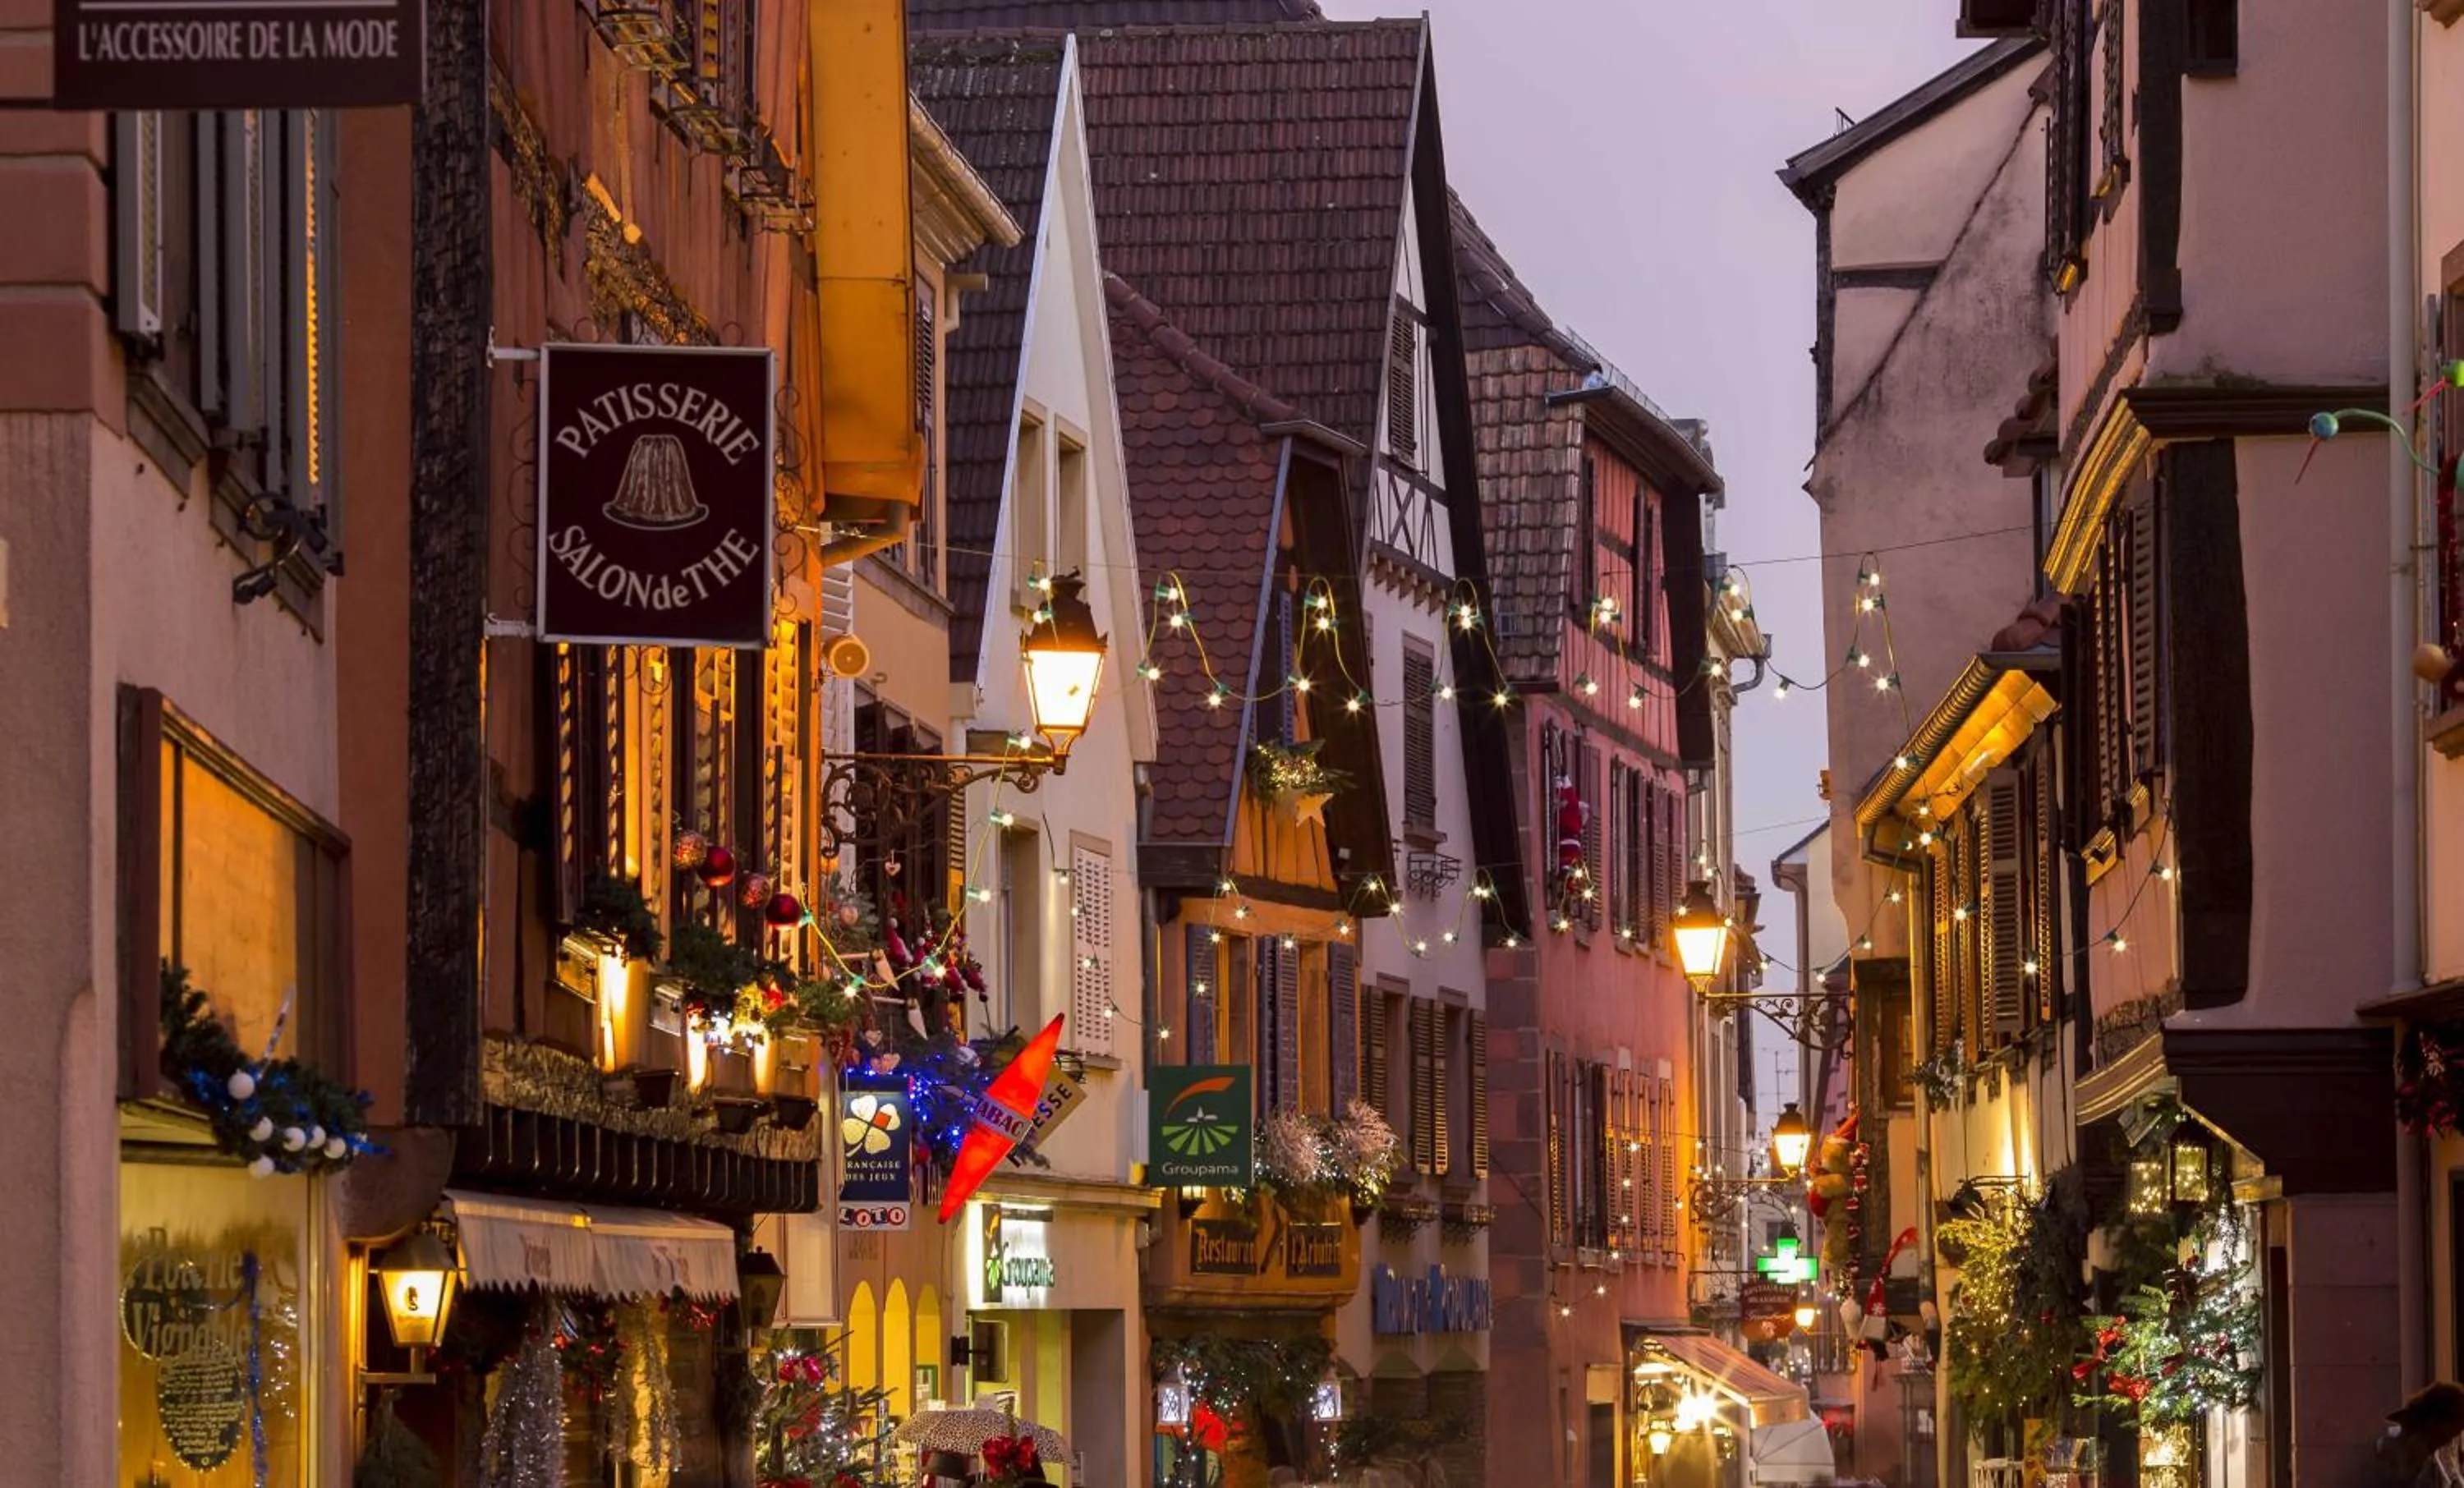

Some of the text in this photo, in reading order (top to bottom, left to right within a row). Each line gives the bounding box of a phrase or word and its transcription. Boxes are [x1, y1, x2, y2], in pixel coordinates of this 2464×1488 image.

[79, 19, 399, 61] L'ACCESSOIRE DE LA MODE
[554, 383, 761, 466] PATISSERIE
[847, 1160, 902, 1170] RANÇAISE
[1162, 1162, 1239, 1178] Groupama
[869, 1173, 897, 1183] JEUX
[839, 1206, 906, 1228] LOTO
